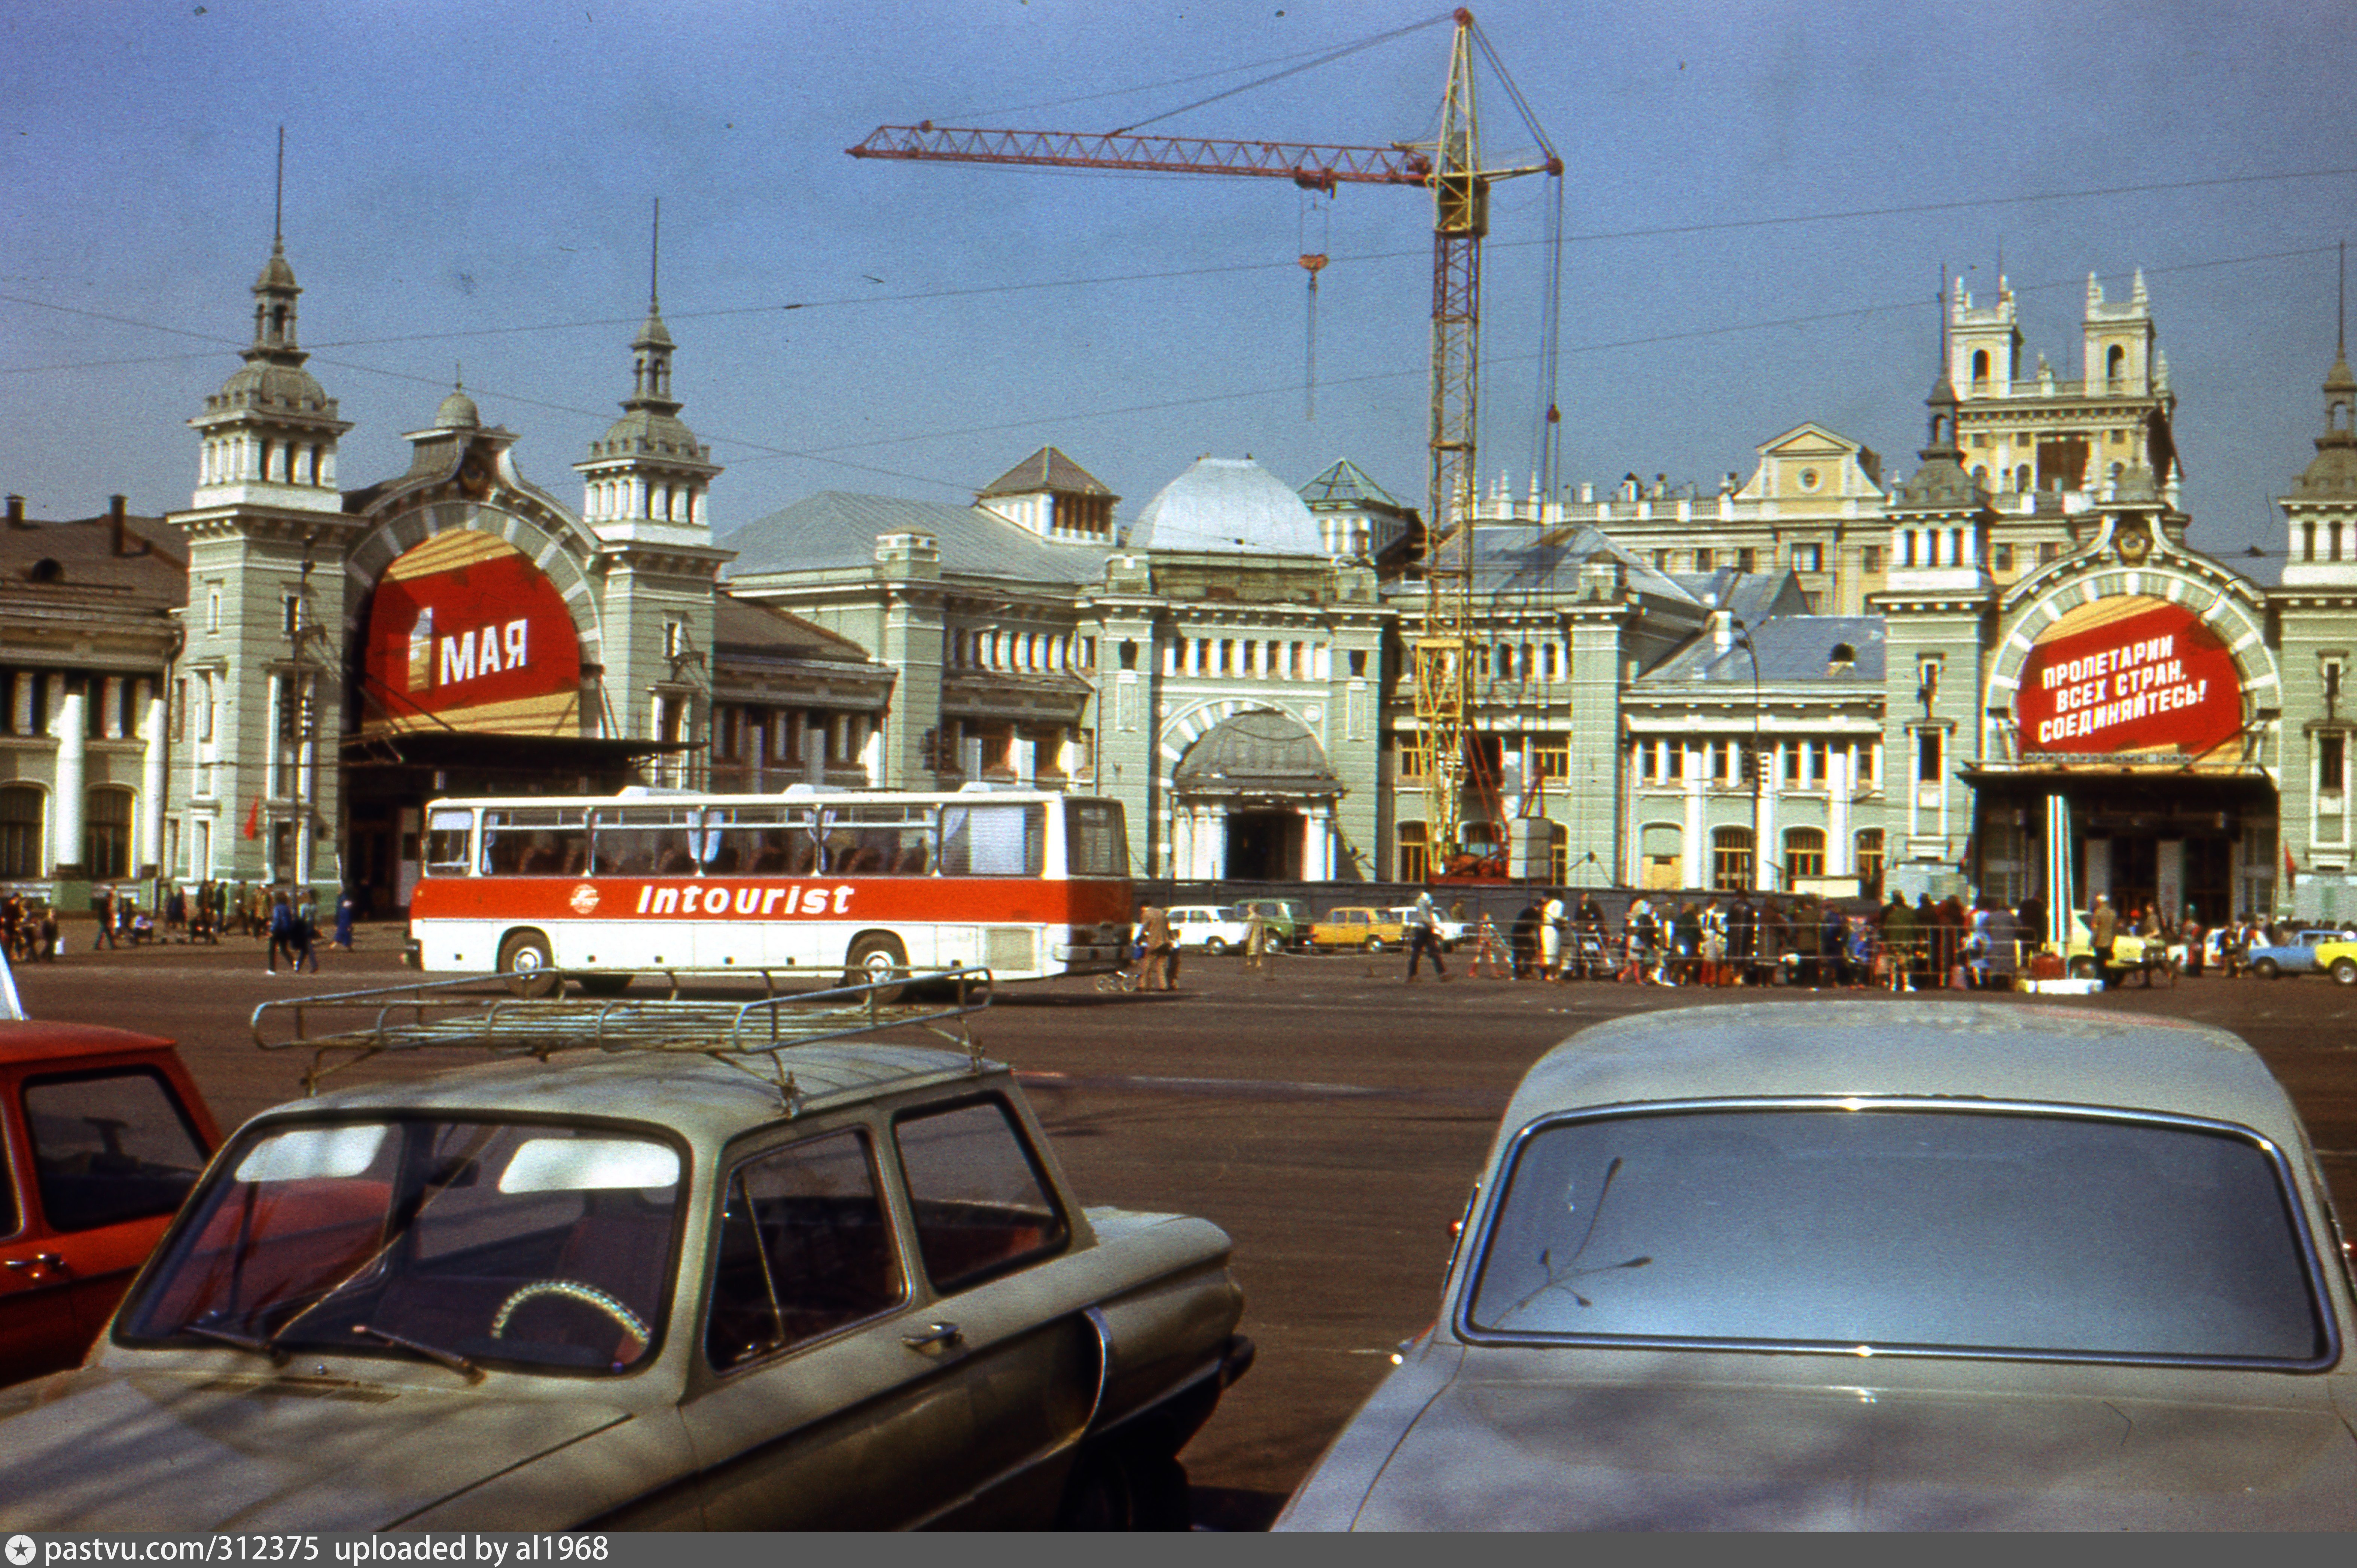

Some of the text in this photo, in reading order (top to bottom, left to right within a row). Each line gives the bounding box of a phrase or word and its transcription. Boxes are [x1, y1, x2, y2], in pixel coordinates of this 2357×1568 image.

[408, 605, 527, 693] 1 МАЯ
[2042, 635, 2174, 690] ПРОЛЕТАРИИ
[2038, 680, 2207, 743] СОЕДИНЯЙТЕСЬ!
[2056, 677, 2107, 713] ВСЕХ
[637, 885, 854, 914] Intourist
